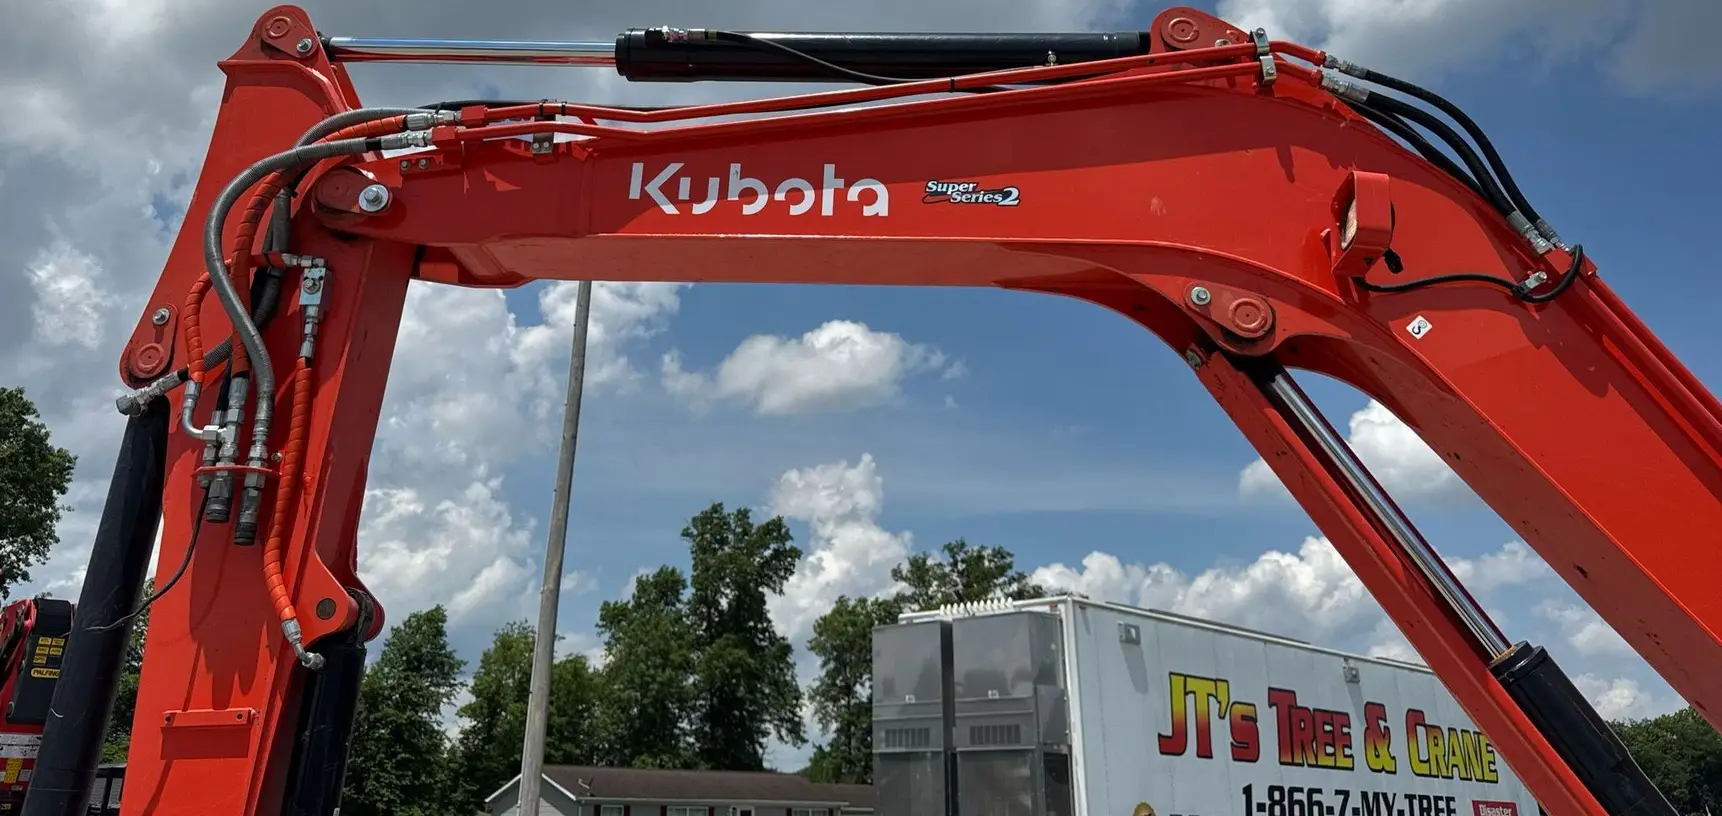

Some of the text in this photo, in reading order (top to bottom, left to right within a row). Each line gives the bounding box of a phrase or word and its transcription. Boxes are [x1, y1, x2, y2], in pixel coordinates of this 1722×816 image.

[628, 162, 889, 216] Kubota
[925, 180, 977, 195] Super
[1364, 701, 1397, 774] &
